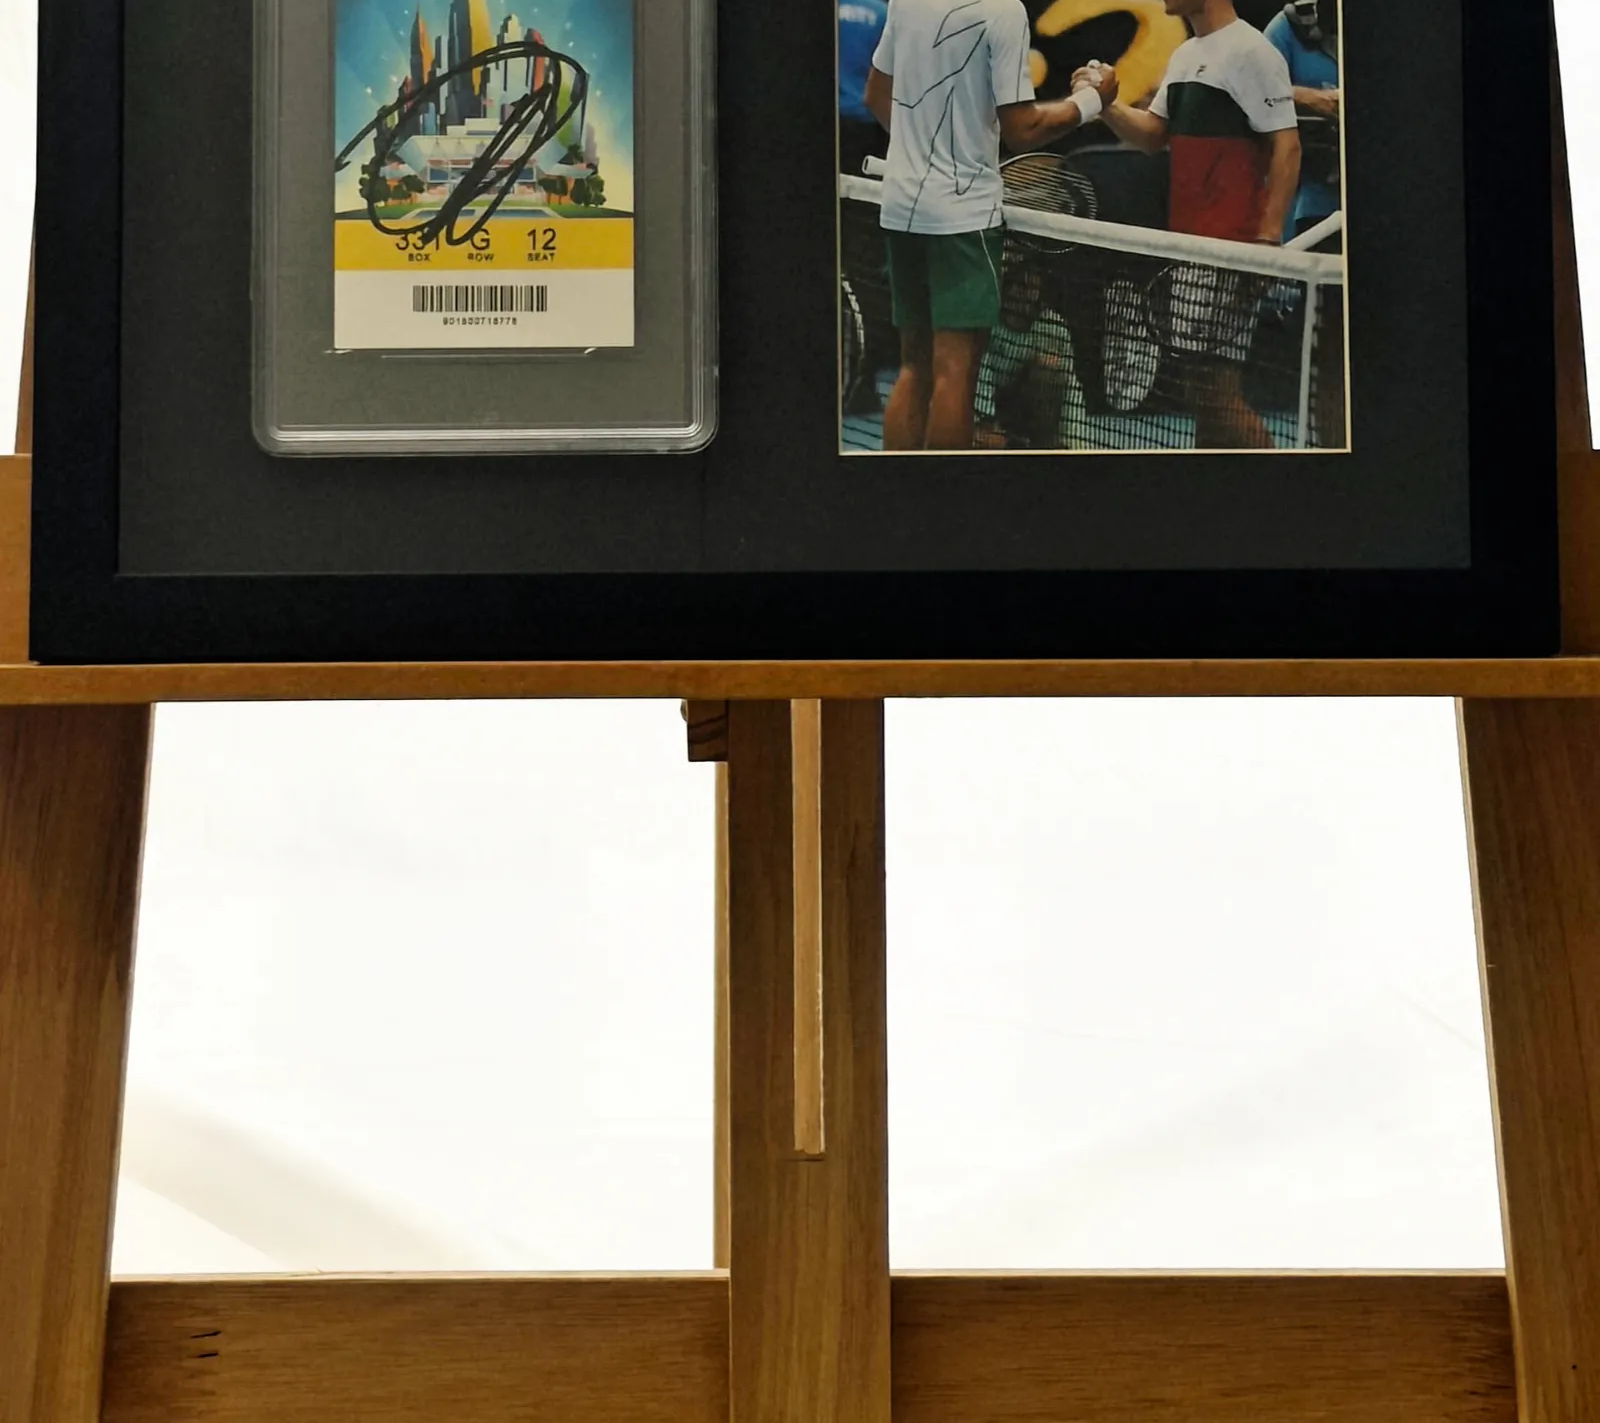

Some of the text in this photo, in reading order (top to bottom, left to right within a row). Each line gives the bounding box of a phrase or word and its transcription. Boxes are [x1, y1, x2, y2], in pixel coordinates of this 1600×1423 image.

[470, 228, 490, 251] G
[527, 227, 556, 251] 12
[408, 252, 555, 262] BOX ROW SEAT
